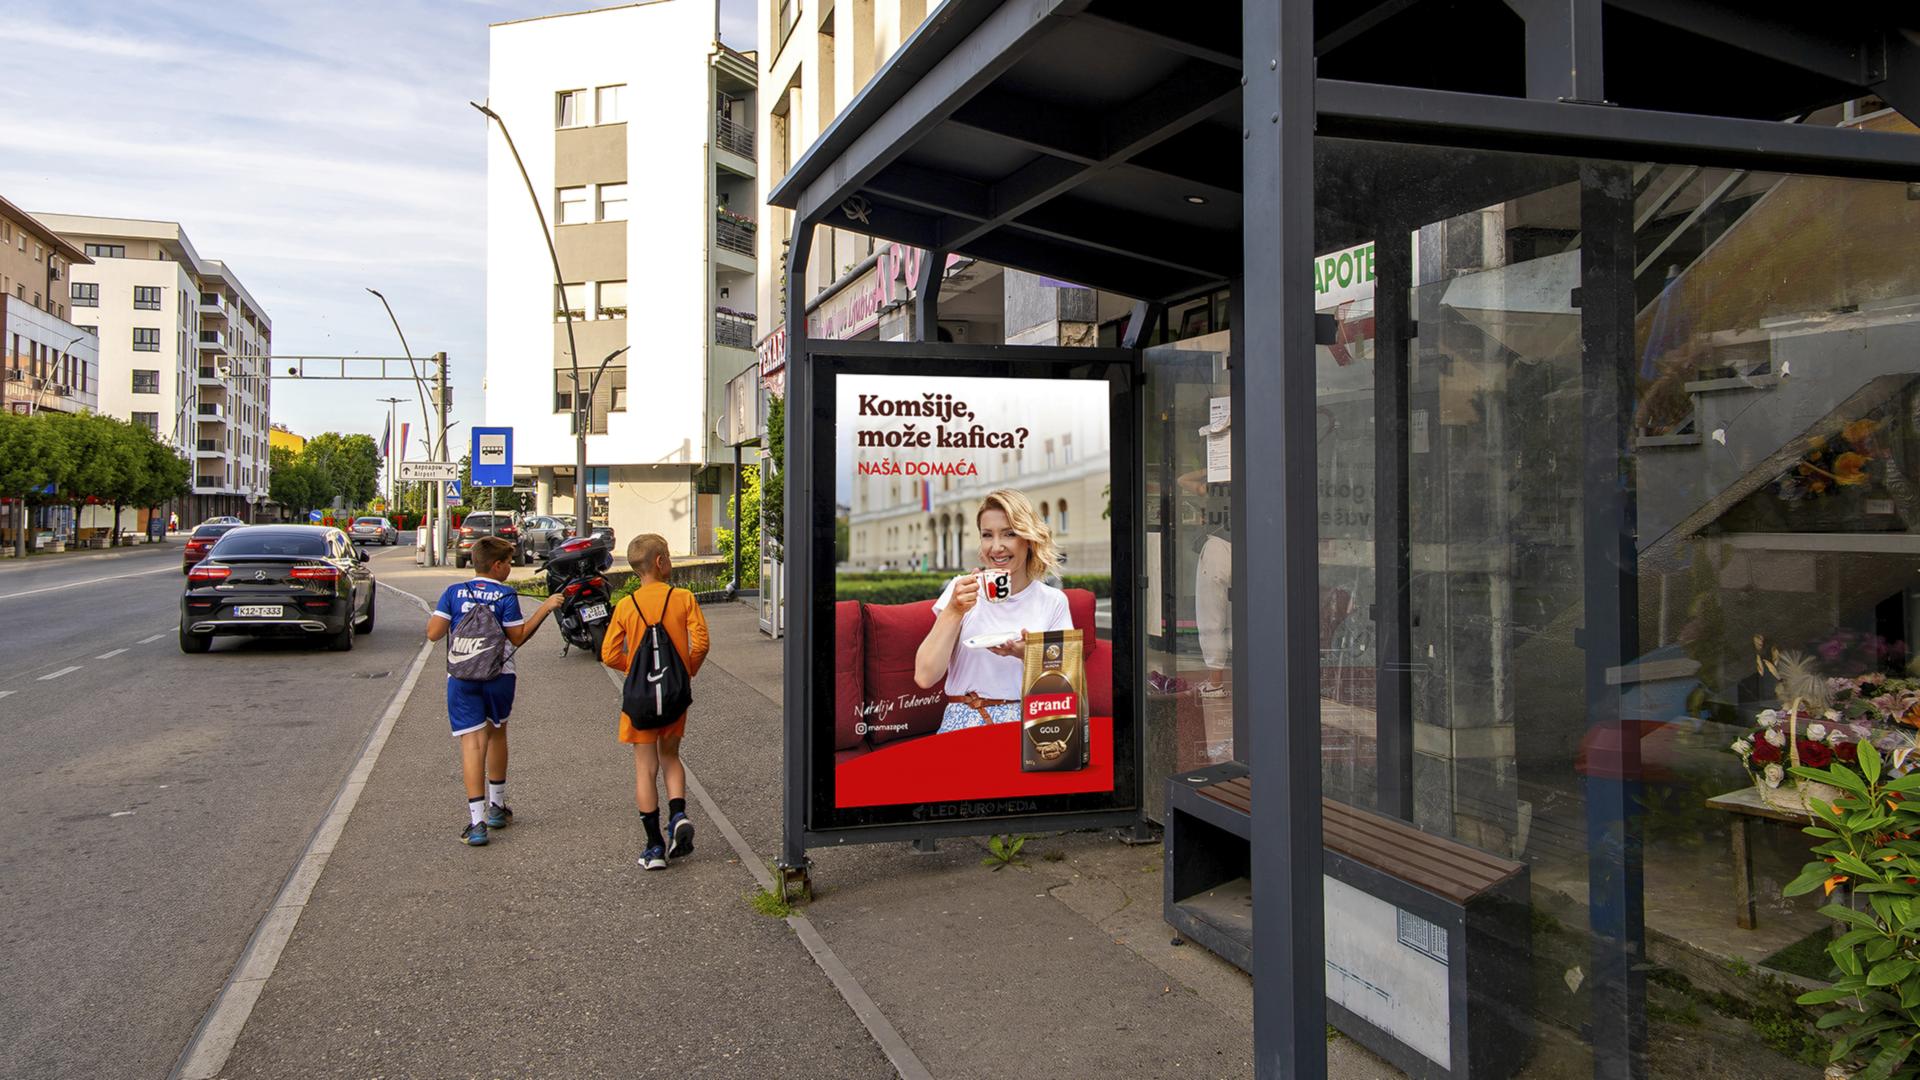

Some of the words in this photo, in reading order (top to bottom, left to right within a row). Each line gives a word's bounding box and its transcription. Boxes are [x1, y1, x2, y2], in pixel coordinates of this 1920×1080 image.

[1315, 245, 1375, 294] APOTE
[858, 392, 975, 423] Komšije,
[858, 424, 931, 448] može
[936, 424, 1029, 449] kafica?
[858, 458, 901, 475] NAŠA
[905, 458, 978, 475] DOMAĆA
[239, 607, 281, 616] K12-T-333
[452, 637, 487, 654] NIKE
[854, 700, 894, 721] Natalija
[1029, 697, 1071, 715] grand
[868, 723, 909, 733] mamazapet
[1039, 726, 1060, 734] GOLD
[930, 804, 957, 817] LED
[997, 800, 1038, 814] MEDIA
